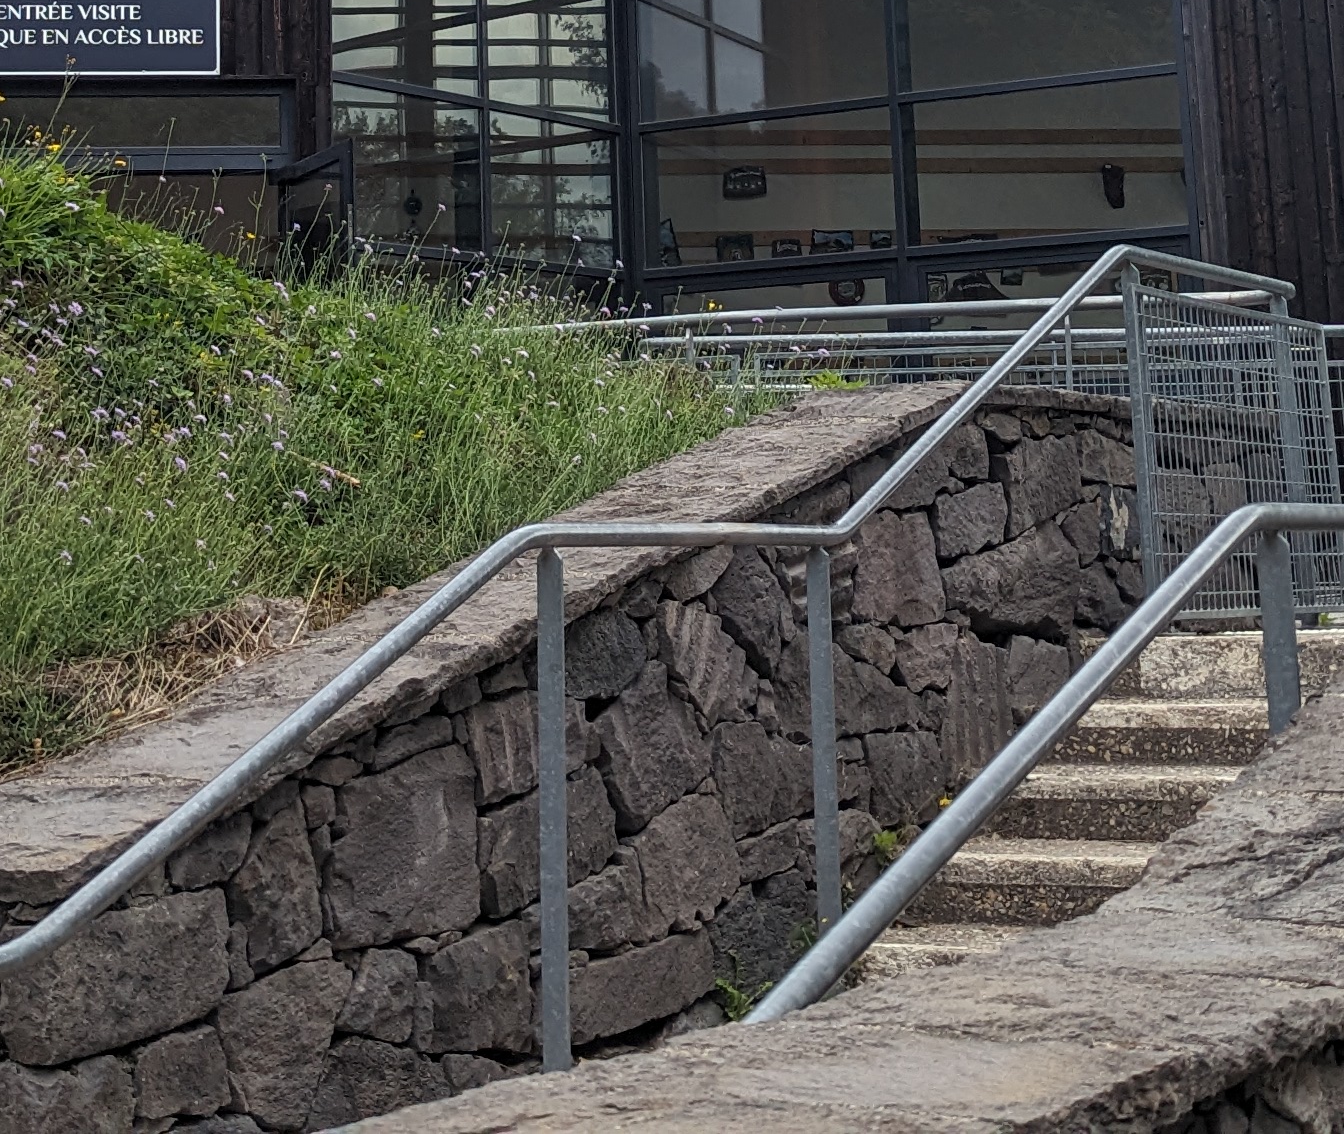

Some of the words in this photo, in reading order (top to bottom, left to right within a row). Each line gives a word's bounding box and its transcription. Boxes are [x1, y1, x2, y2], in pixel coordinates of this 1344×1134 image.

[77, 4, 142, 20] VISITE
[41, 28, 69, 45] EN
[74, 26, 142, 45] ACCÈS
[146, 28, 205, 45] LIBRE
